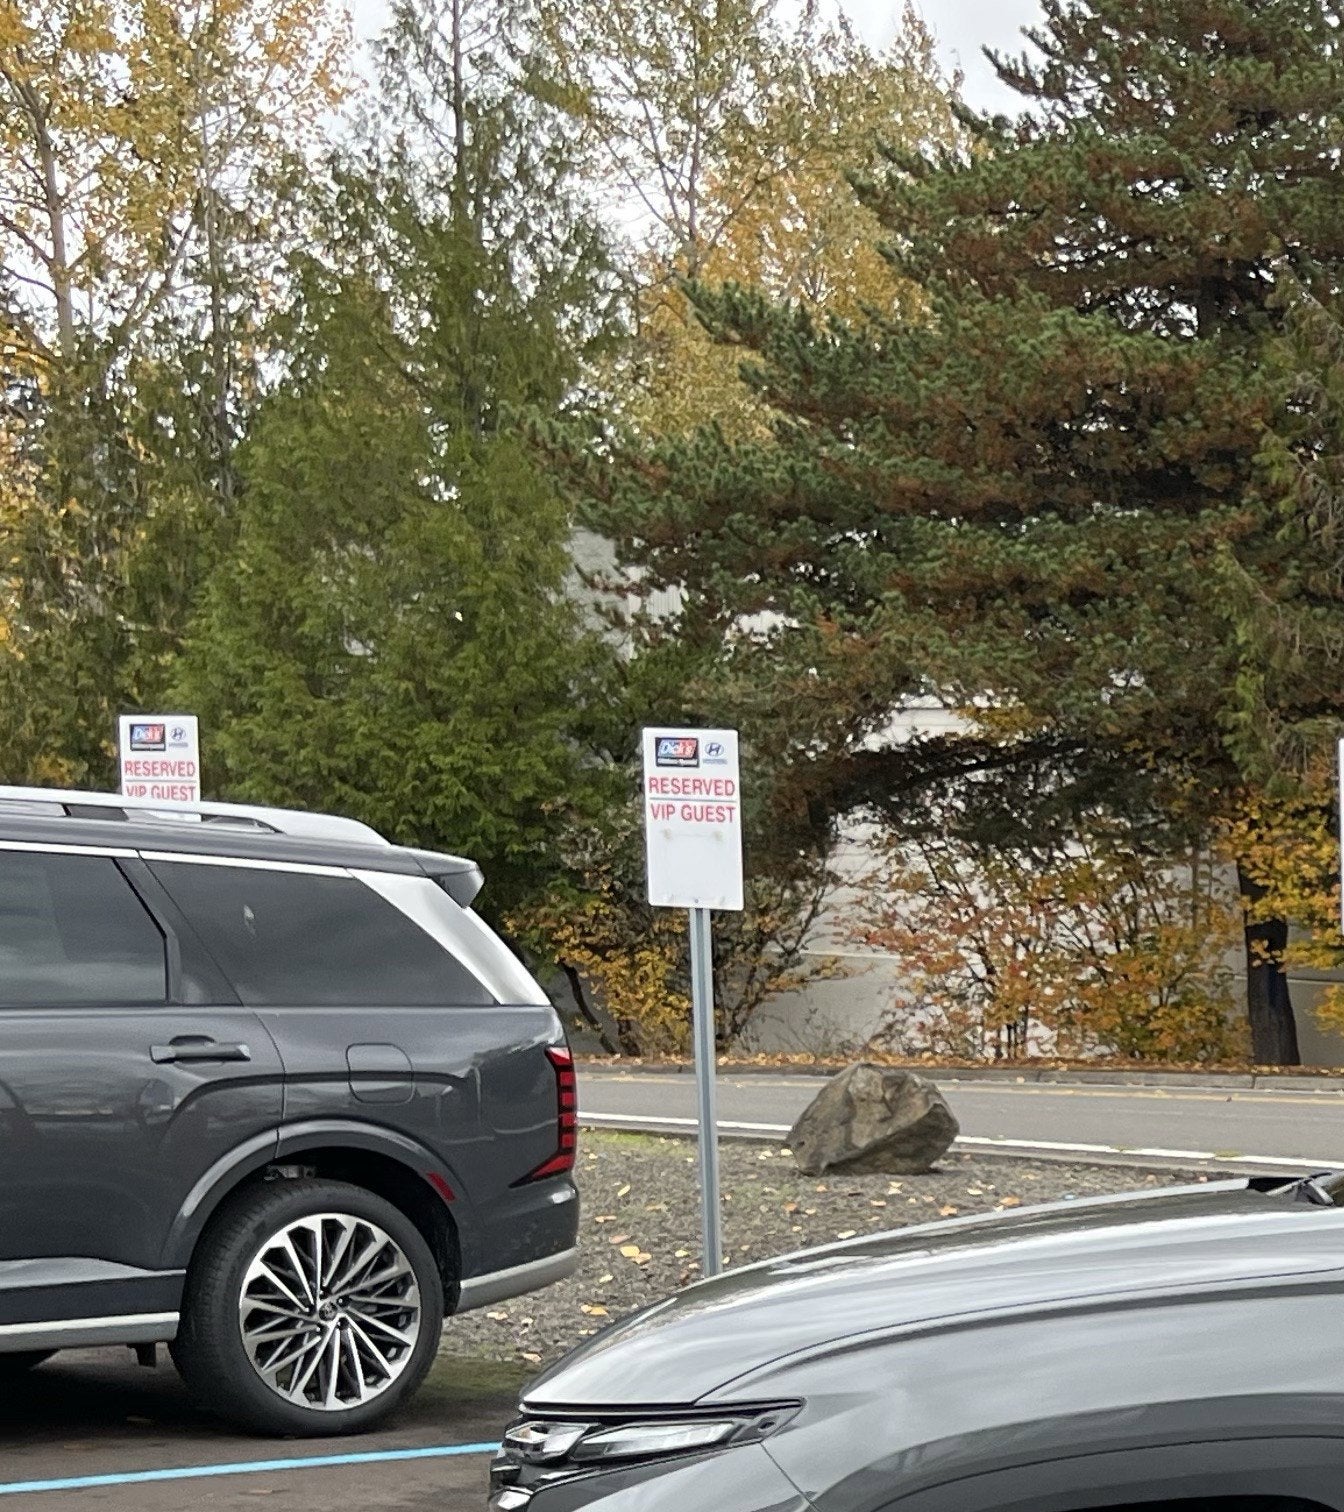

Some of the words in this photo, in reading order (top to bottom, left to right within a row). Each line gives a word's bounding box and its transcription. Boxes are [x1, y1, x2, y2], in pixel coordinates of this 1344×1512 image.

[124, 760, 196, 777] RESERVED
[126, 784, 147, 798] VIP
[151, 785, 197, 801] GUEST
[648, 776, 736, 797] RESERVED
[650, 803, 676, 821] VIP
[680, 805, 737, 824] GUEST
